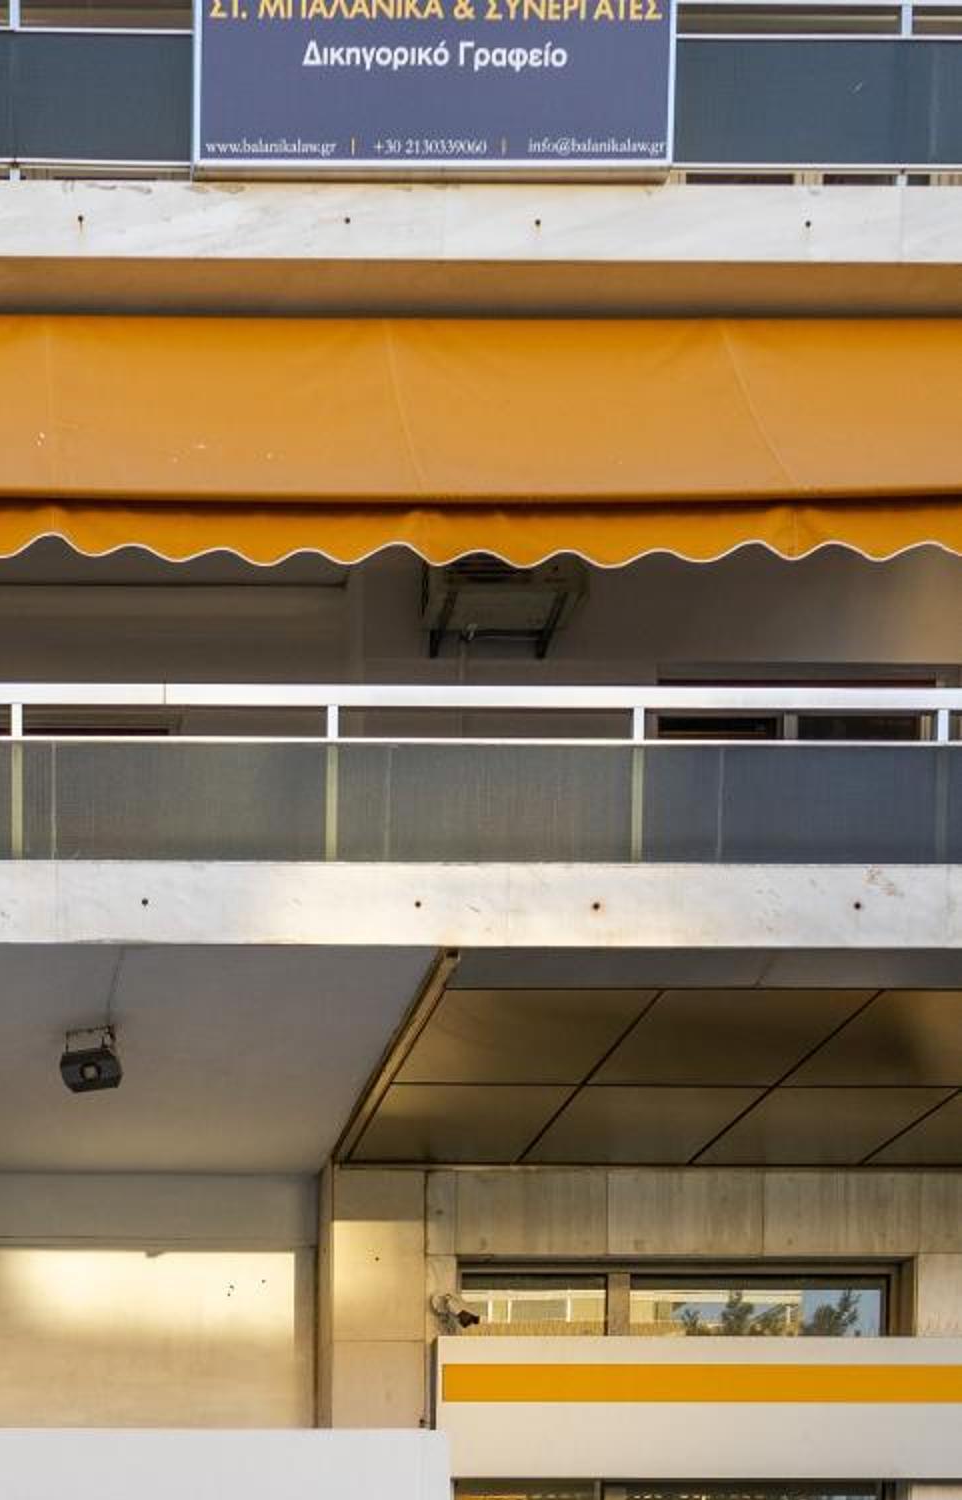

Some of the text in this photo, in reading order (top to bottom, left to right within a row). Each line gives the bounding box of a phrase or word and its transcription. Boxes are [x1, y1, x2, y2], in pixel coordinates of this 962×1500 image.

[303, 40, 568, 72] Δικηγορικό Γραφείο
[205, 138, 337, 157] www.balanikalaw.gr
[374, 139, 401, 155] +30
[528, 138, 666, 157] info@balanikalaw.gr
